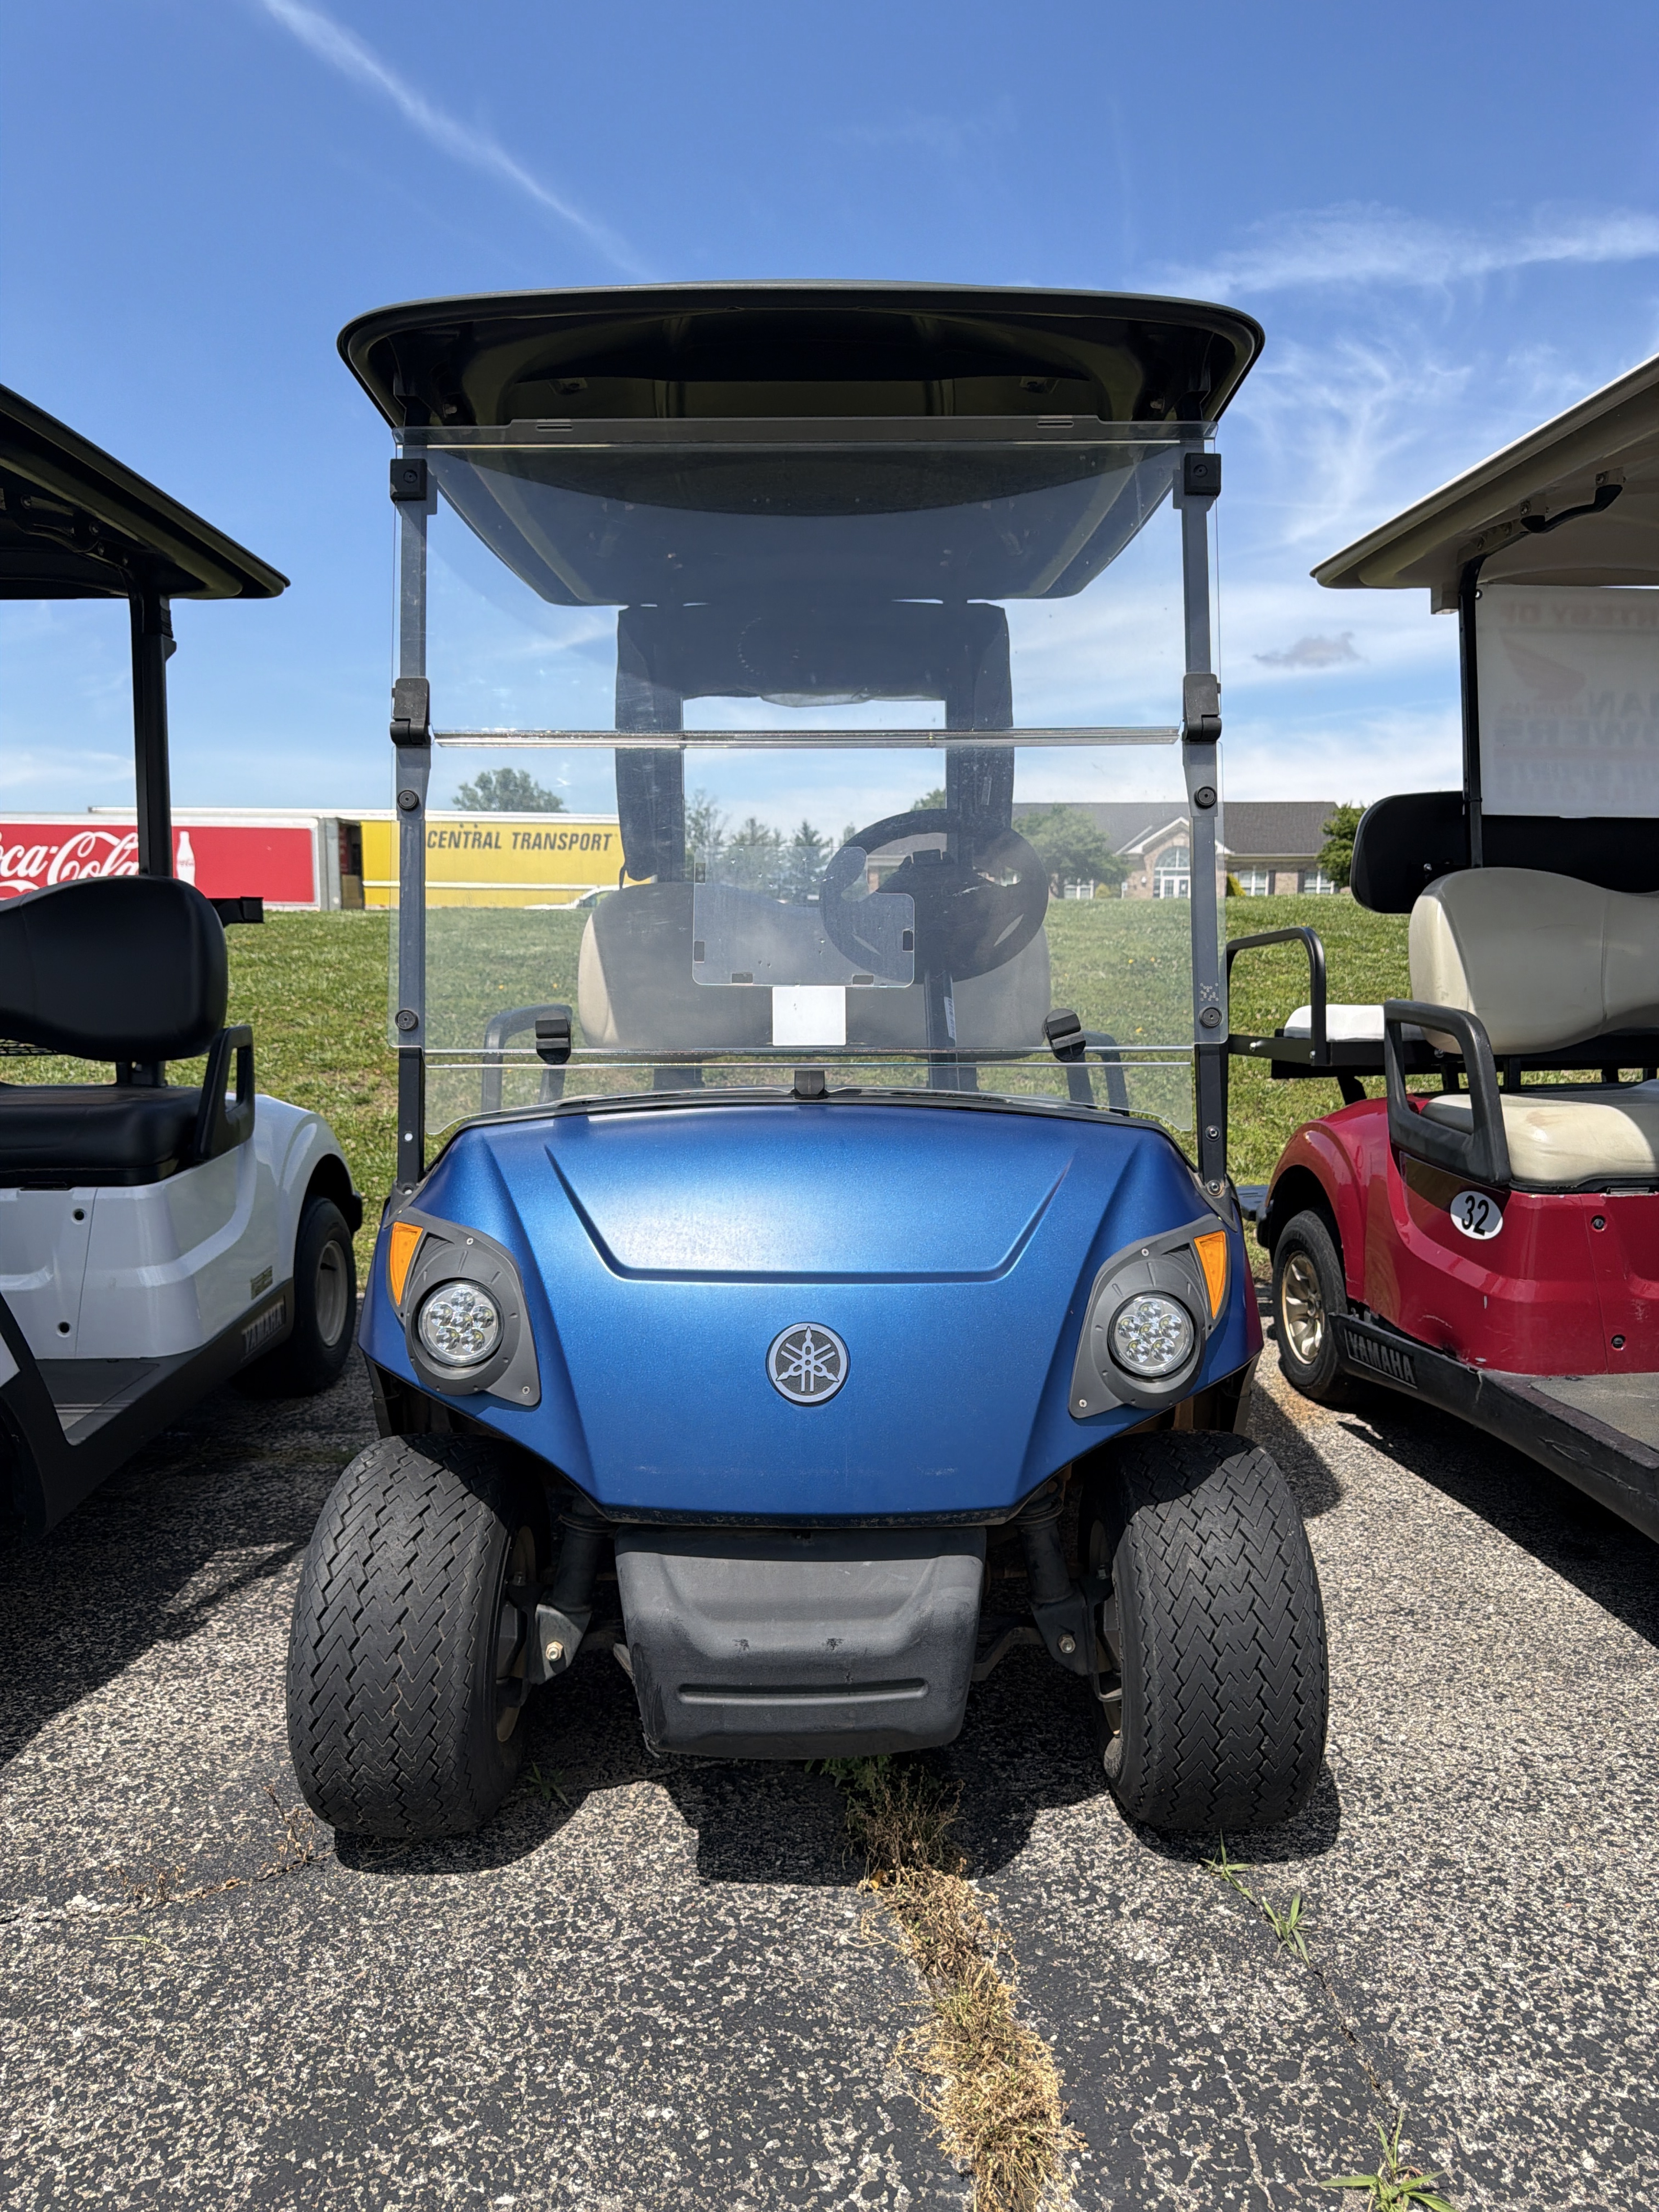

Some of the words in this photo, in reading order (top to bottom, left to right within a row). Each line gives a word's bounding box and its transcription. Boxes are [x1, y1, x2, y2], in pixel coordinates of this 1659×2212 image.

[427, 830, 502, 849] CENTRAL
[512, 832, 613, 851] TRANSPORT
[1461, 1195, 1489, 1236] 32
[1348, 1331, 1416, 1384] YAMAHA
